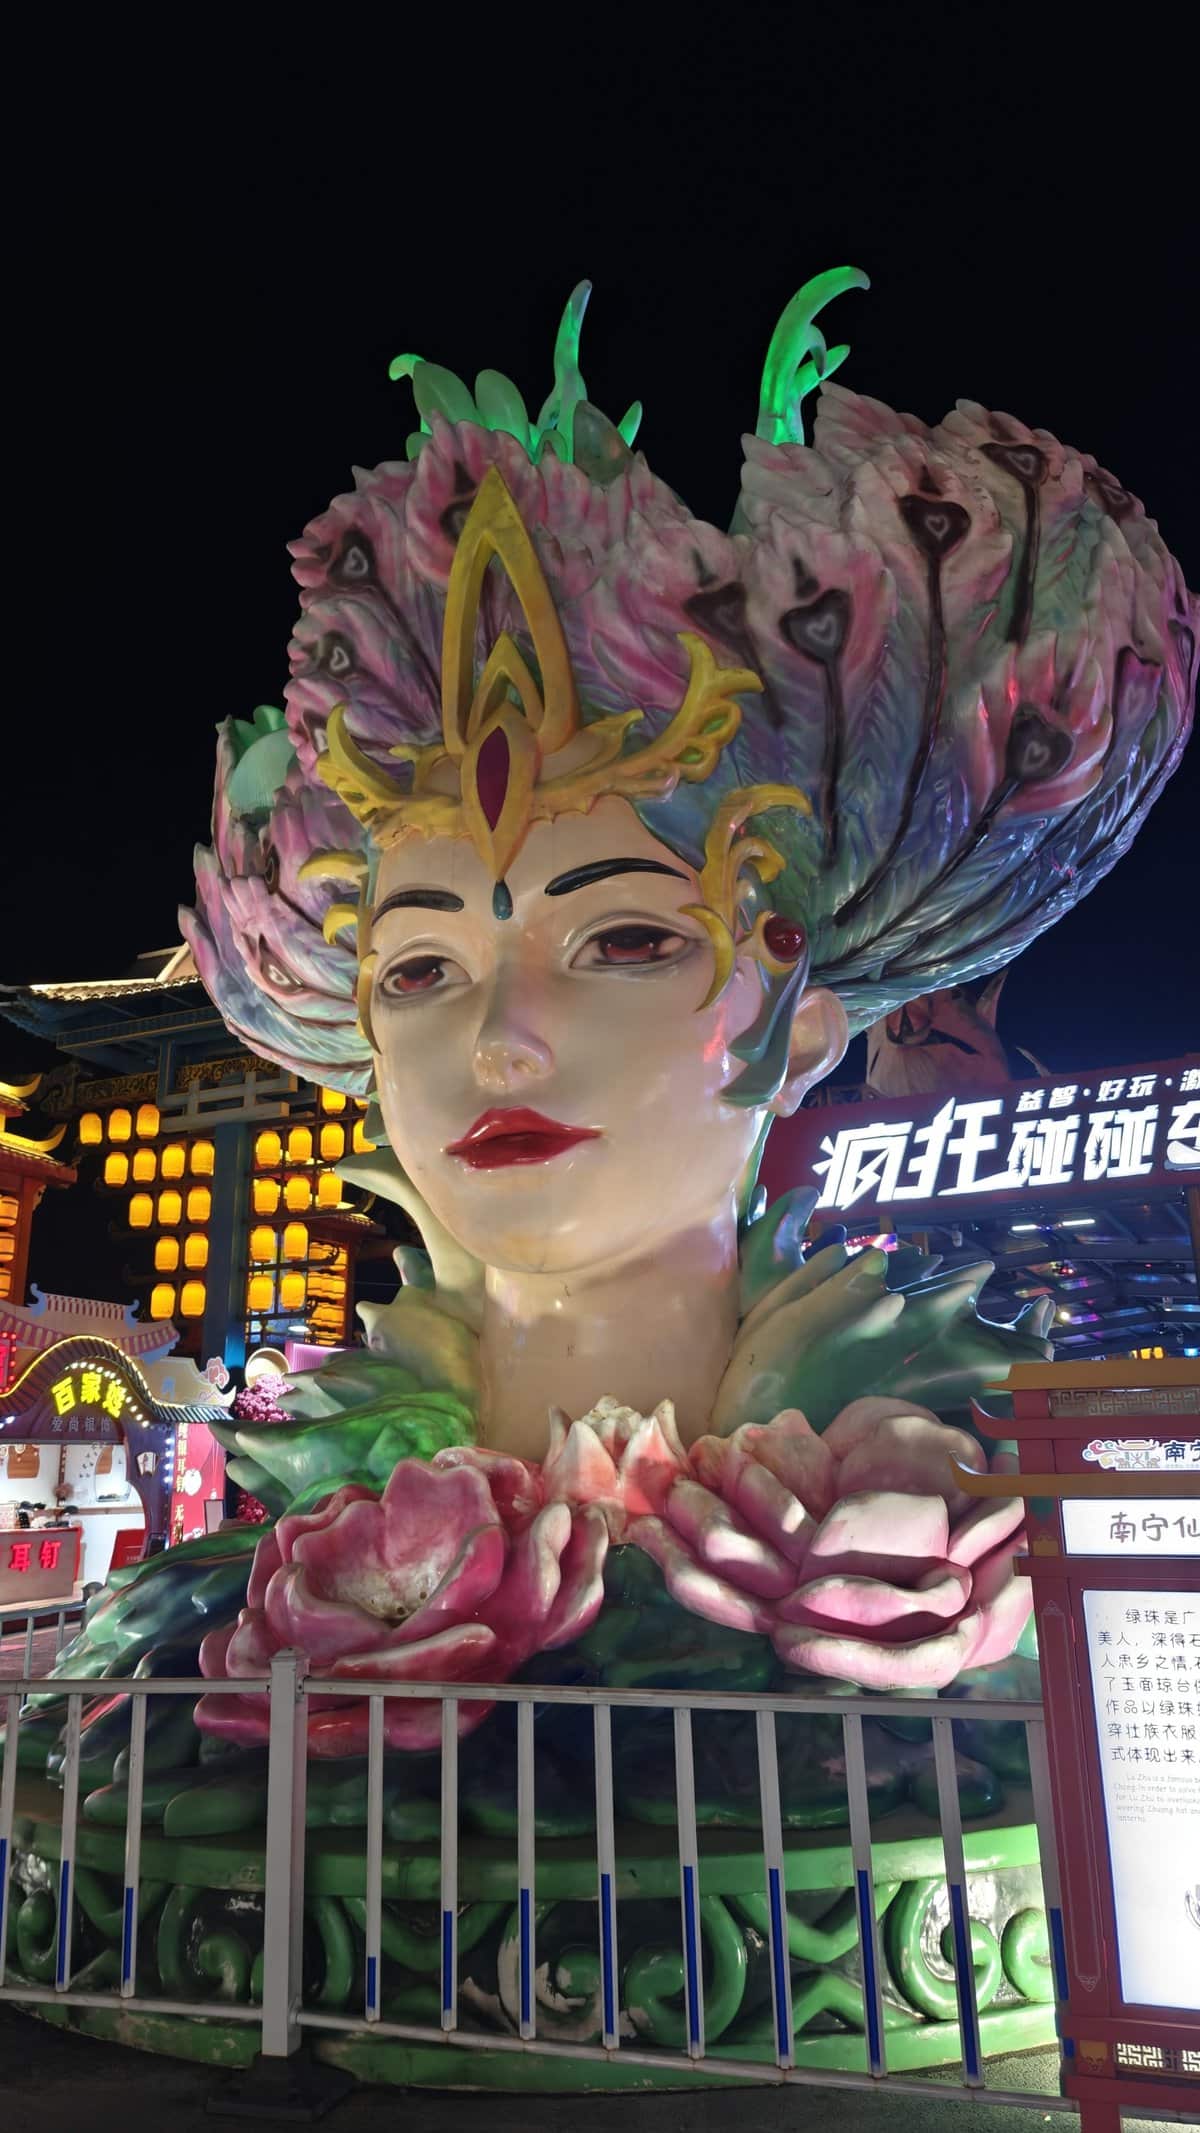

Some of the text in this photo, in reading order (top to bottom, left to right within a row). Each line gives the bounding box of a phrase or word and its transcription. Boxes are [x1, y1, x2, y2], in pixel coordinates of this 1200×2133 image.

[1109, 1511, 1200, 1543] 南宁仙
[8, 1540, 62, 1573] 耳钉
[1125, 1608, 1196, 1625] 绿珠是广
[1106, 1699, 1200, 1717] 作品以绿珠
[1107, 1722, 1196, 1740] 穿壮族衣服
